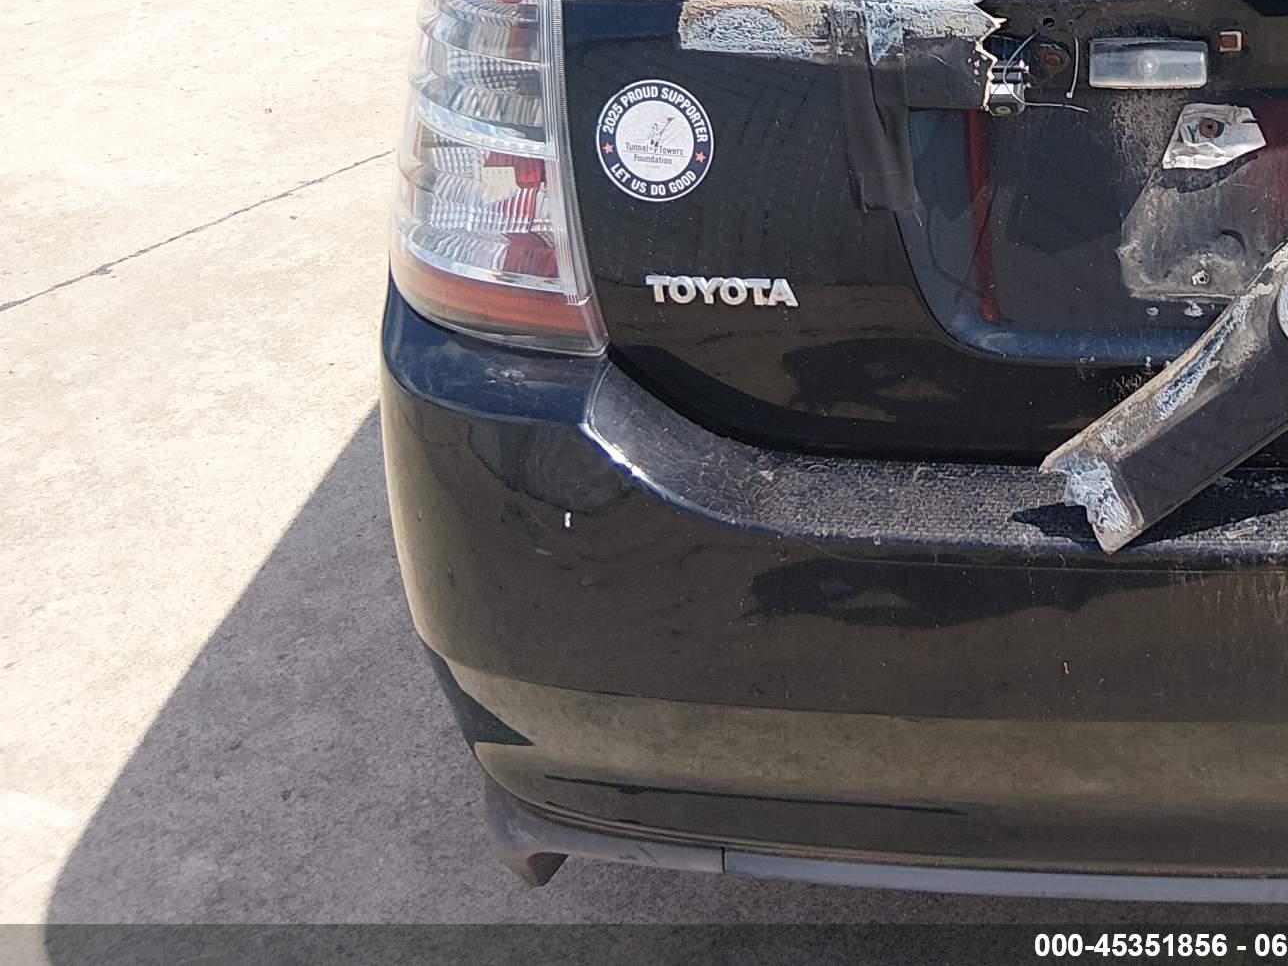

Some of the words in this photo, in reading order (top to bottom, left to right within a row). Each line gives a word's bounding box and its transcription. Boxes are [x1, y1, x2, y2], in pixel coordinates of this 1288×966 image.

[603, 102, 624, 135] 2025
[619, 85, 659, 108] PROUD
[660, 87, 709, 143] SUPPORTER
[625, 142, 649, 152] Tunnel
[634, 153, 673, 165] Foundation
[610, 162, 630, 184] LET
[631, 179, 647, 194] US
[650, 184, 666, 196] DO
[668, 170, 697, 194] GOOD
[645, 274, 799, 307] TOYOTA
